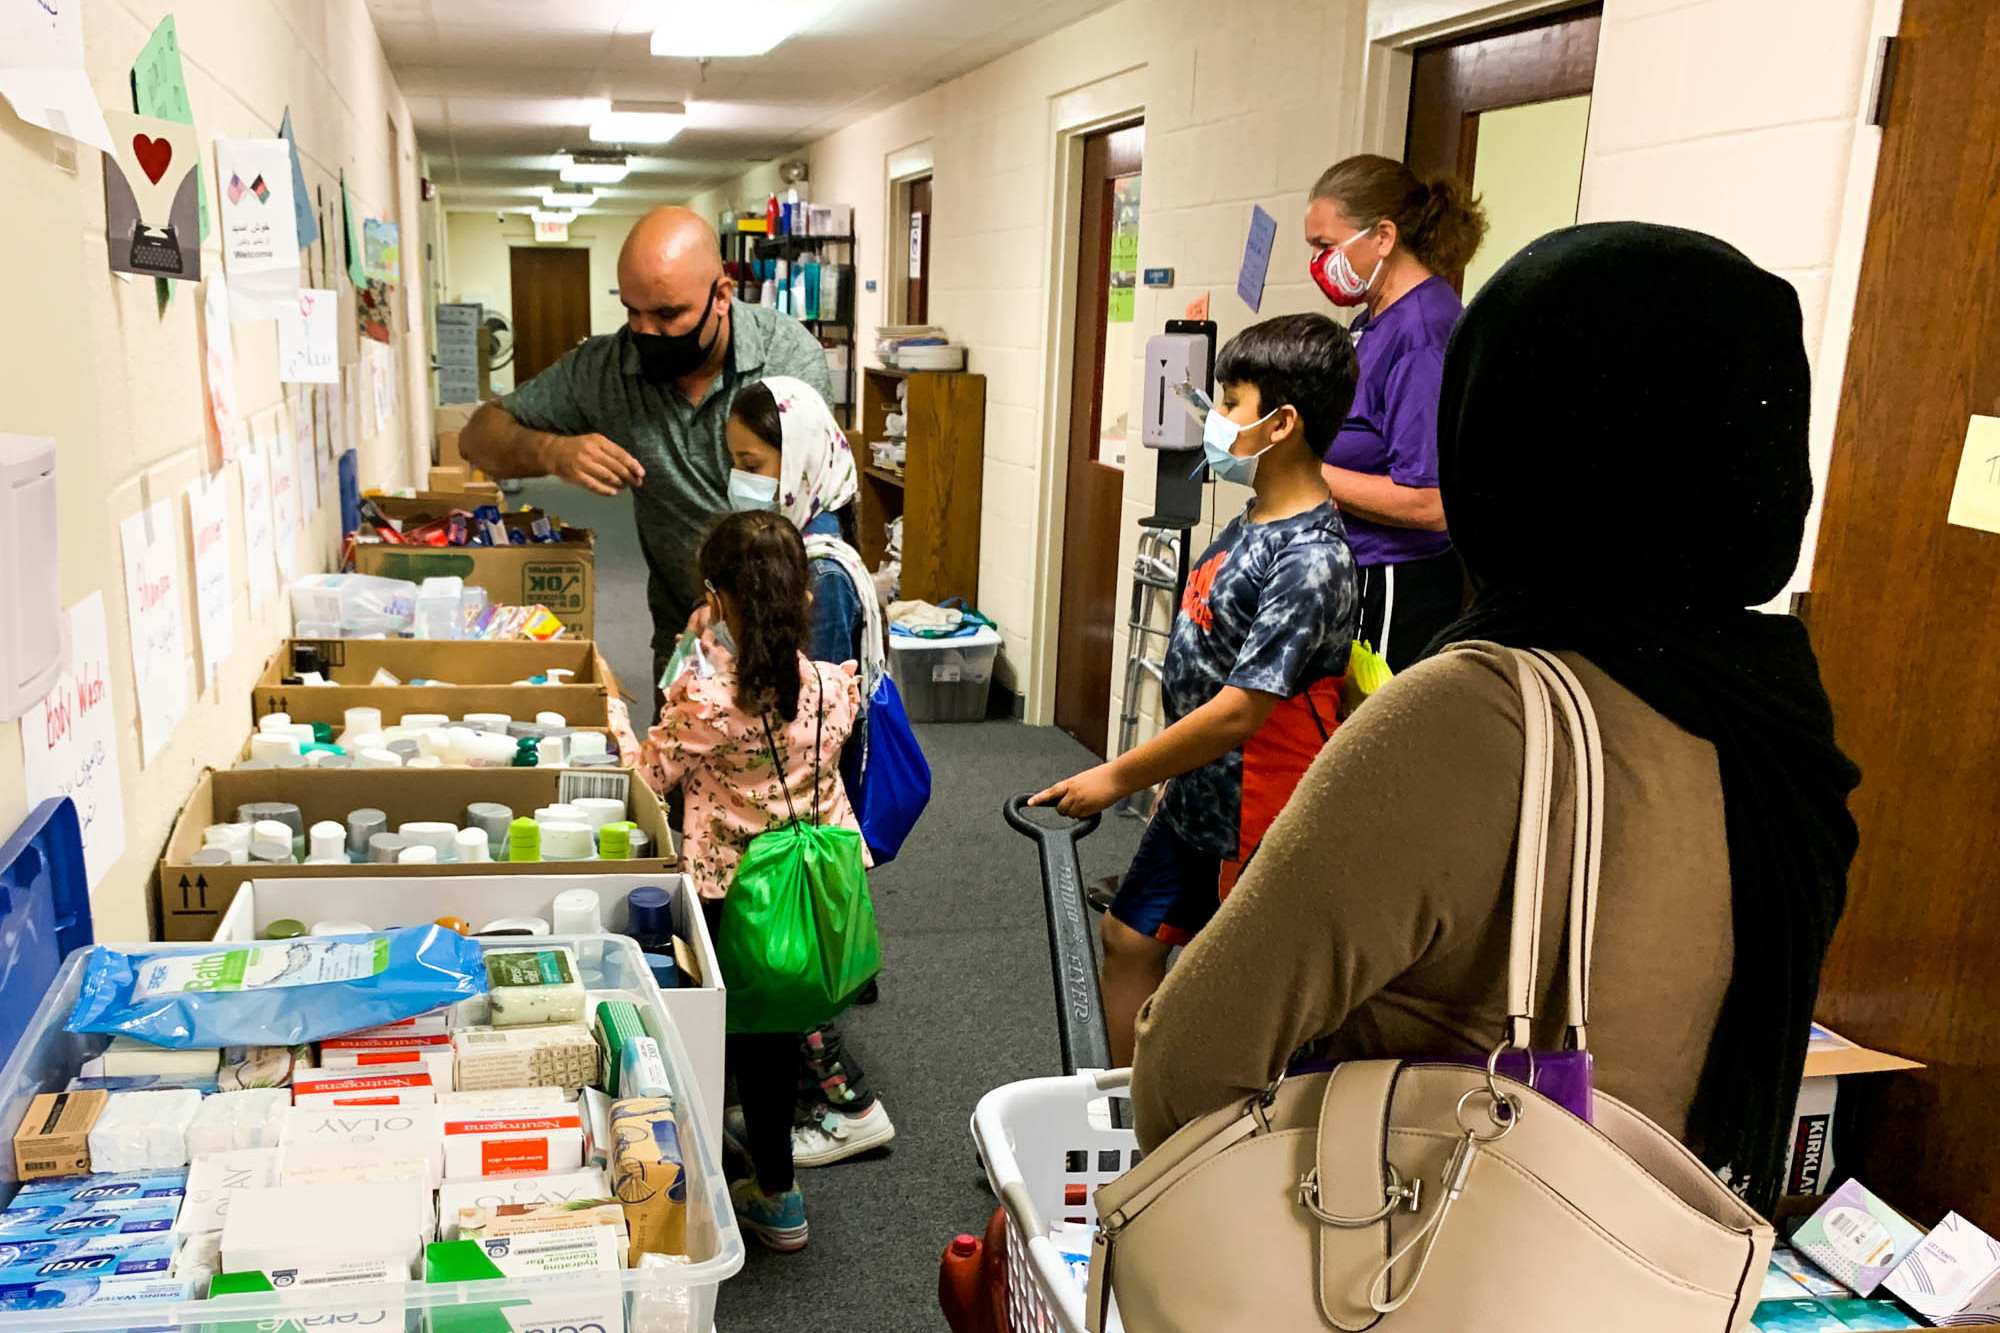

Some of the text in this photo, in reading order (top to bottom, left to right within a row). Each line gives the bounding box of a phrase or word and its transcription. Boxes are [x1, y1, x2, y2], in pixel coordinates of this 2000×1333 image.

[234, 251, 273, 259] Welcome
[528, 576, 562, 591] OK
[45, 659, 105, 750] Body Wash
[1058, 865, 1092, 1024] RADIO FLYER
[183, 952, 228, 992] Bath
[314, 1079, 411, 1092] Neutrogena
[316, 1118, 413, 1135] OLAY
[464, 1120, 561, 1133] Neutrogena
[70, 1184, 138, 1200] Dial
[48, 1217, 117, 1232] Dial
[149, 1221, 161, 1229] 2
[549, 1252, 598, 1263] Cleanser
[37, 1257, 112, 1275] Dial
[146, 1261, 158, 1270] 2
[543, 1260, 599, 1271] Hydrating
[139, 1291, 181, 1300] SPRING
